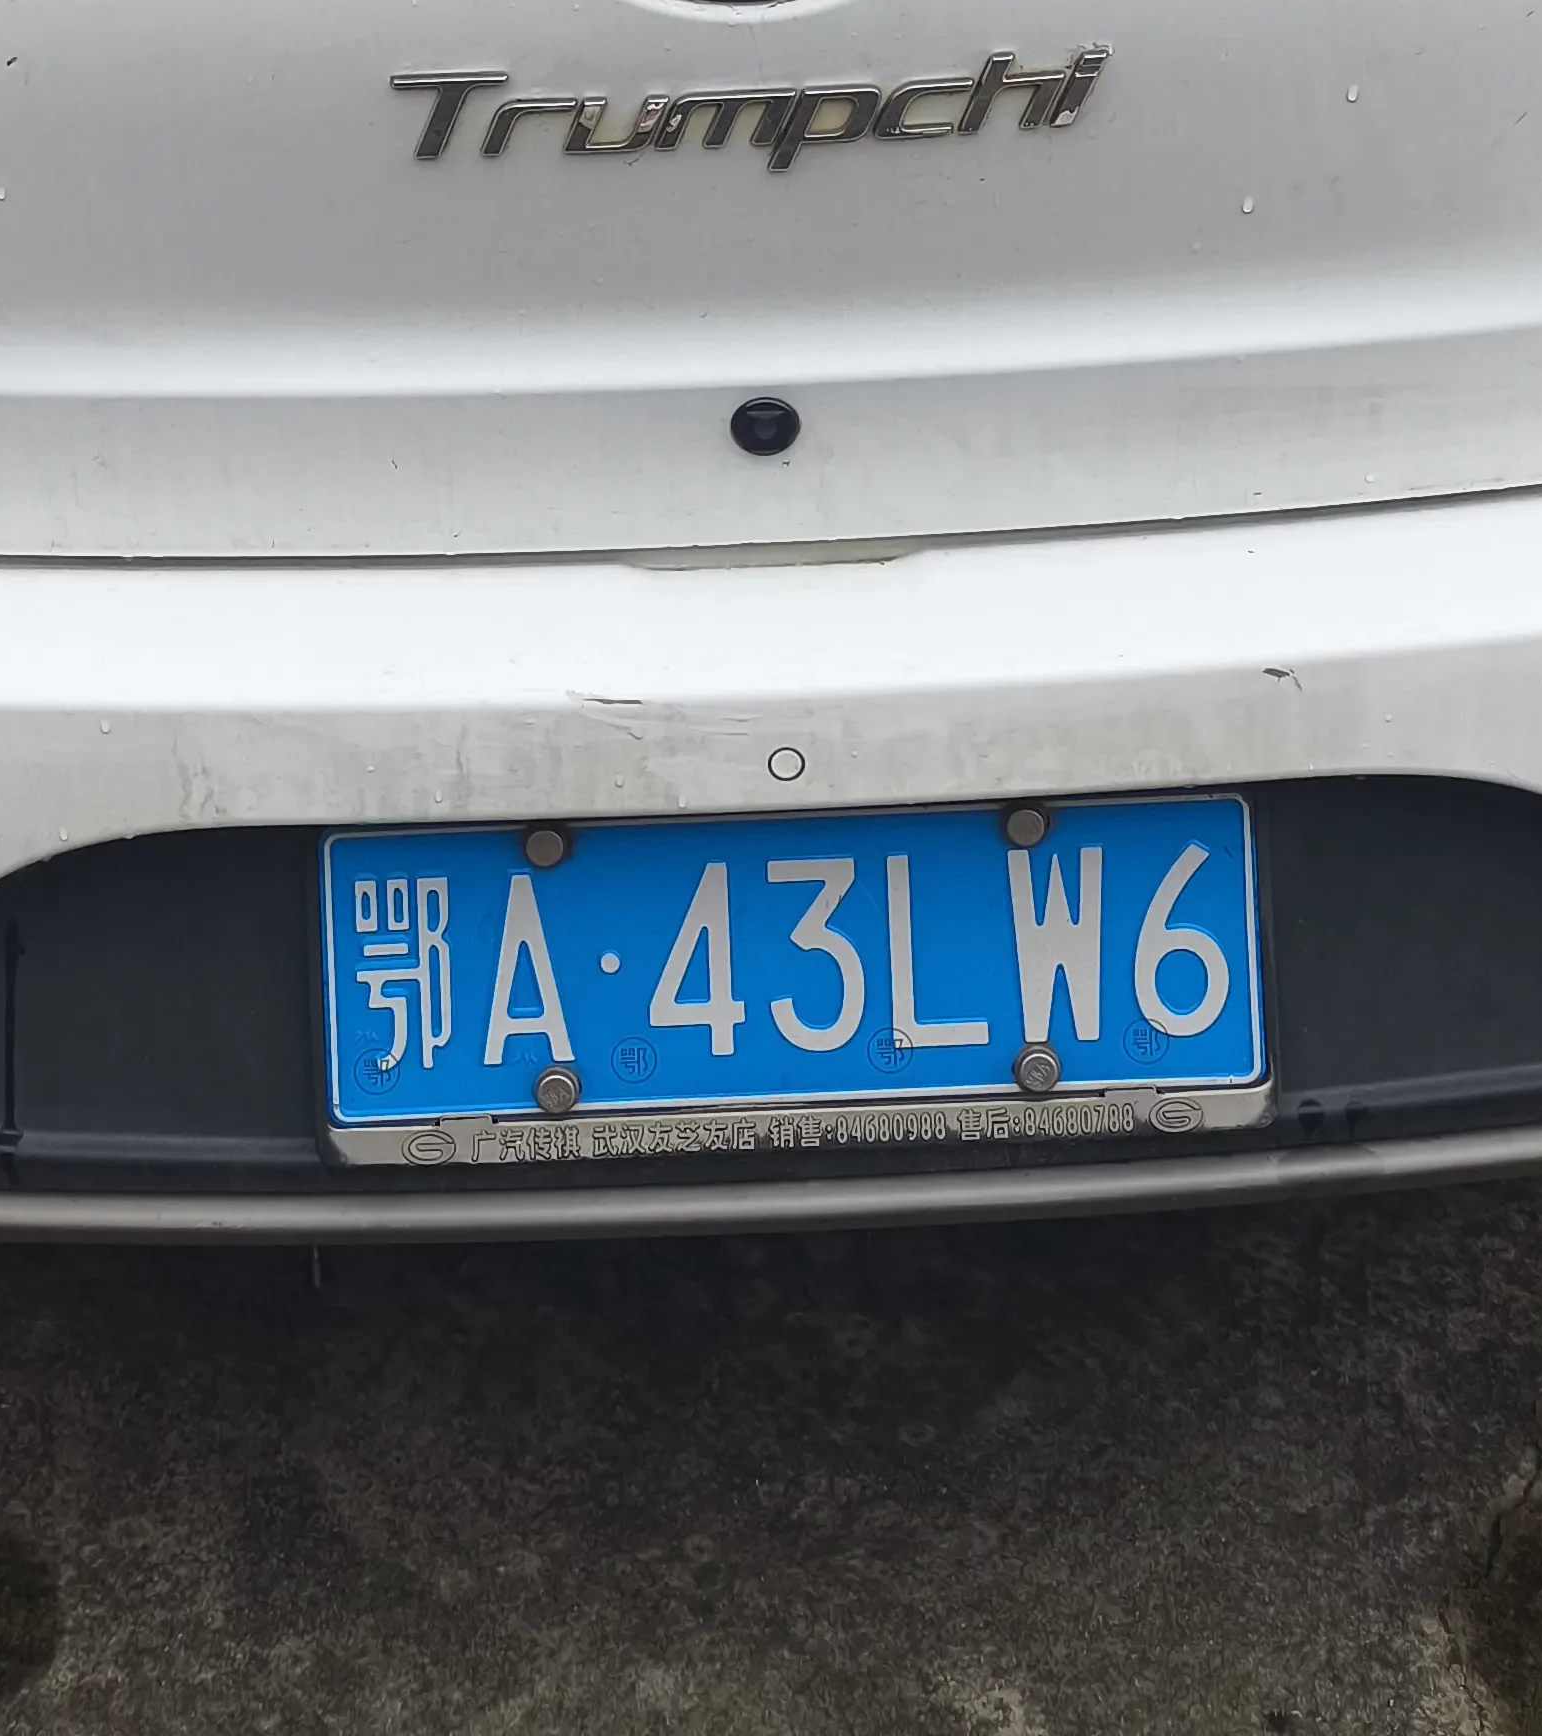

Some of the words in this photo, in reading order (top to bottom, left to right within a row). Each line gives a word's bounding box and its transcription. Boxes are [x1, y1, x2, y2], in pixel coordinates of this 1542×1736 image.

[390, 47, 1113, 172] Trumpchi
[471, 1126, 581, 1164] 广汽传祺
[592, 1117, 757, 1158] 武汉友芝友店
